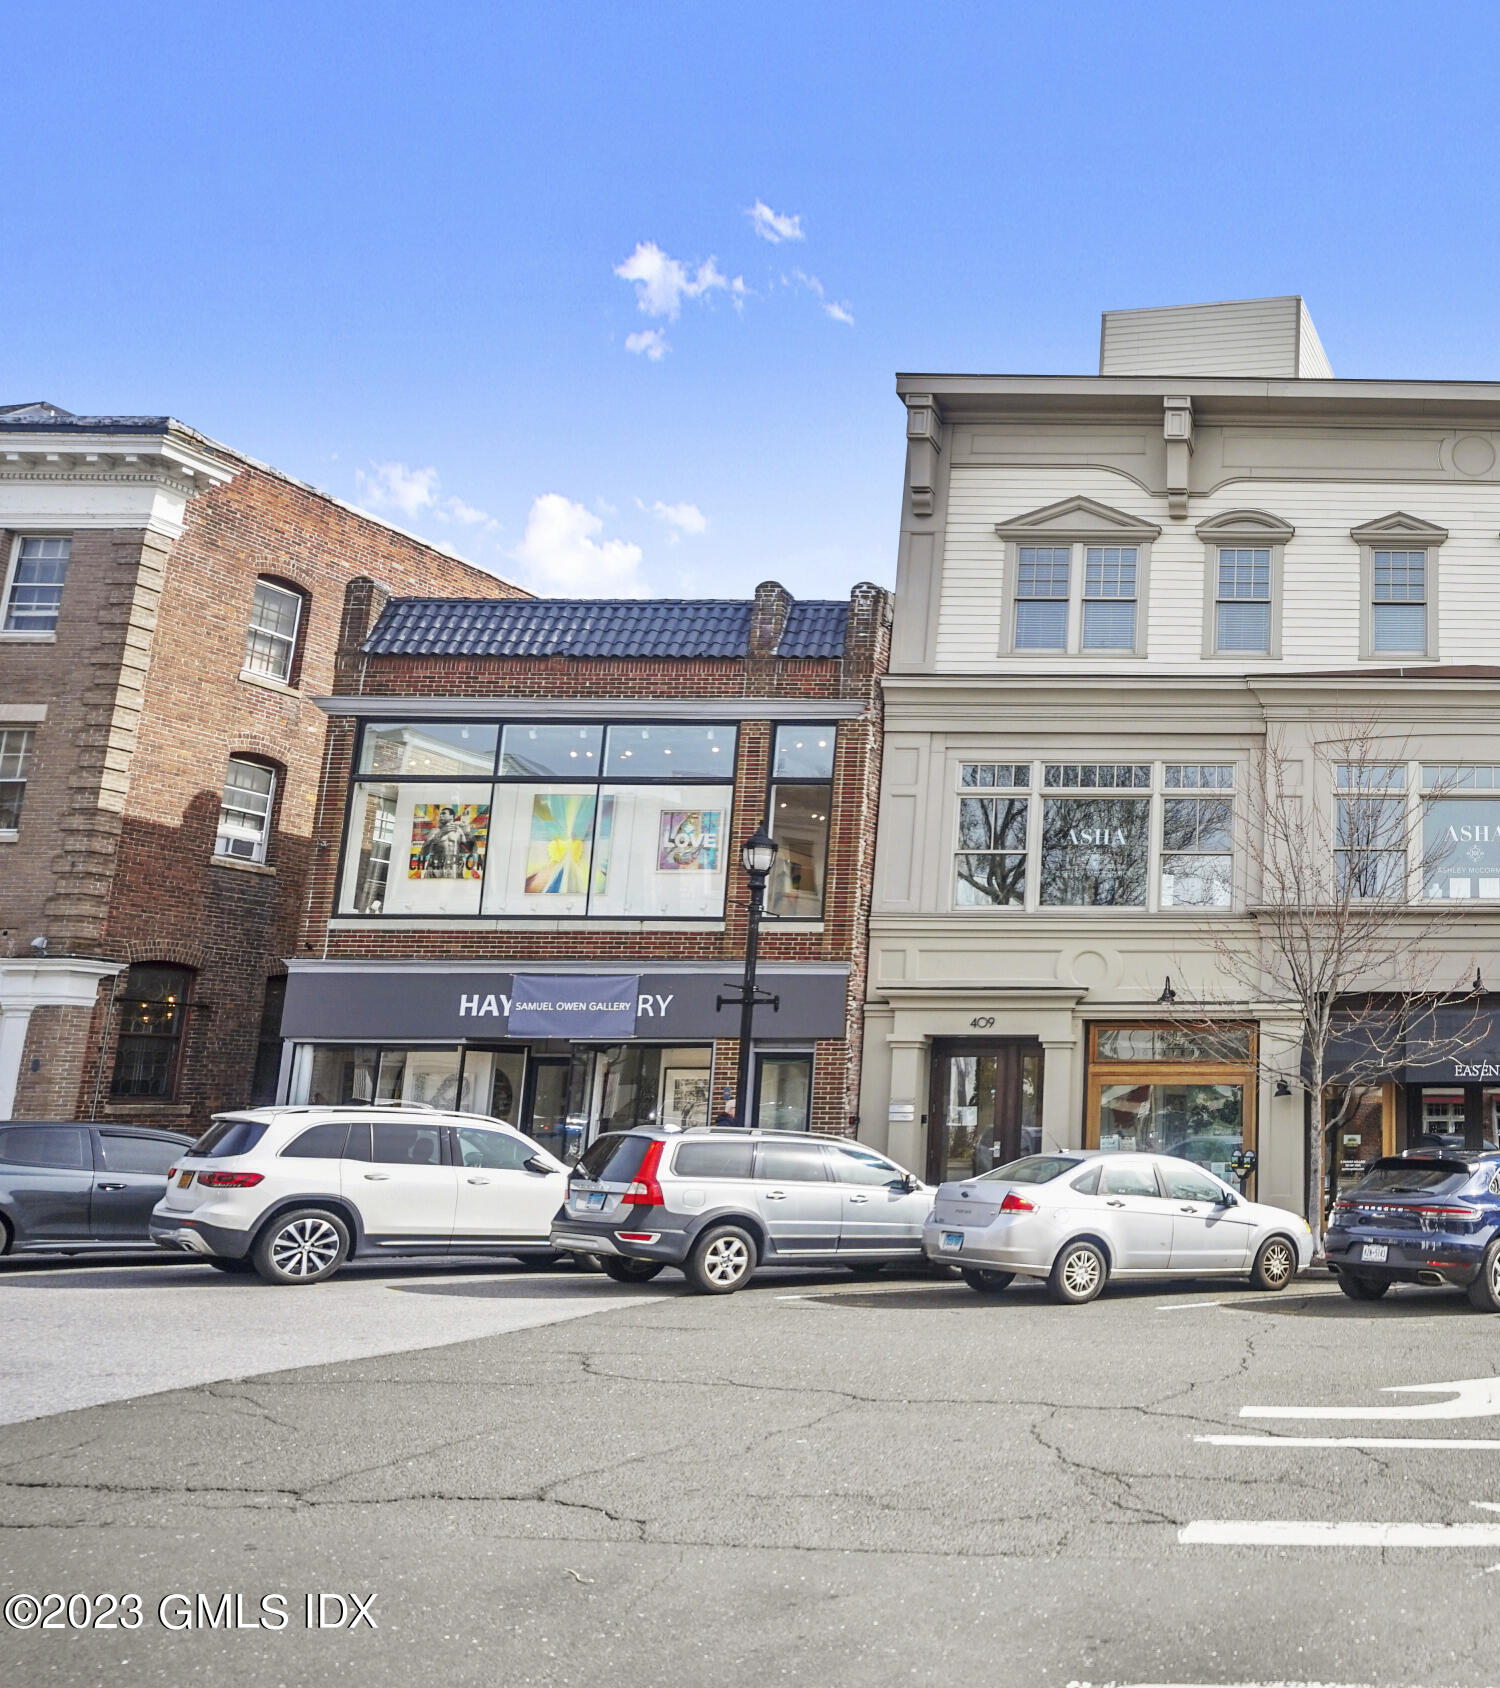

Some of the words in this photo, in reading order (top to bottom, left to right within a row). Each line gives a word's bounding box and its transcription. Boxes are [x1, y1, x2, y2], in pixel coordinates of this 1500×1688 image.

[664, 833, 717, 848] LOVE
[1065, 828, 1126, 846] ASHA
[515, 1002, 554, 1011] SAMUEL
[556, 1002, 587, 1011] OWEN
[589, 1002, 631, 1011] GALLERY
[970, 1016, 995, 1028] 409
